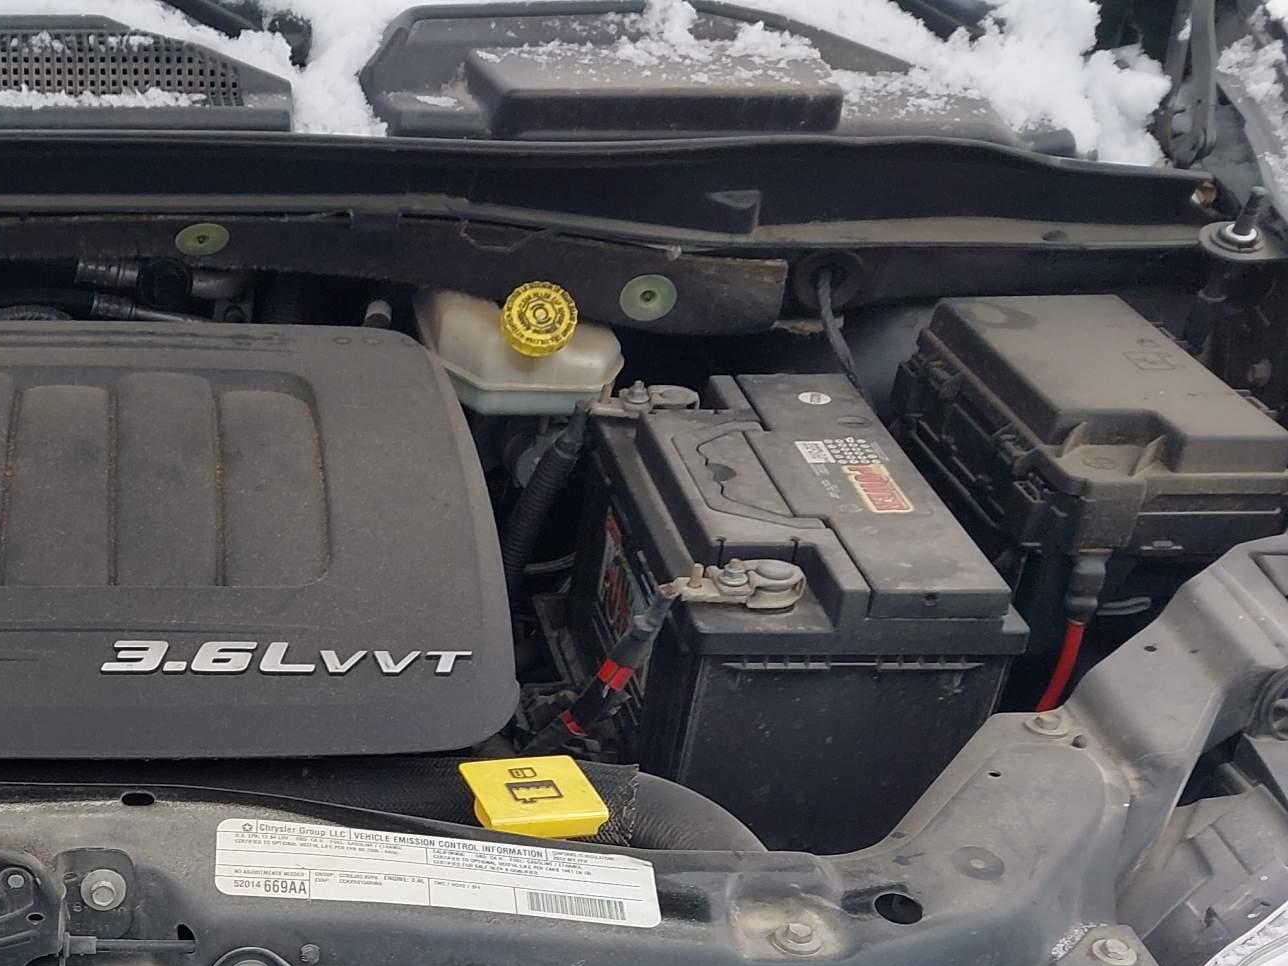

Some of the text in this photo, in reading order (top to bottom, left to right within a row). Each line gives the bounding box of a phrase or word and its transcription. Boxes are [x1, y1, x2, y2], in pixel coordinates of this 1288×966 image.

[259, 824, 346, 839] Chrysler Group LLC
[354, 832, 390, 842] VEHICLE
[394, 837, 436, 847] EMISSION
[439, 840, 480, 852] CONTROL
[482, 845, 543, 858] INFORMATION
[234, 880, 261, 889] 52014
[264, 880, 307, 895] 669AA
